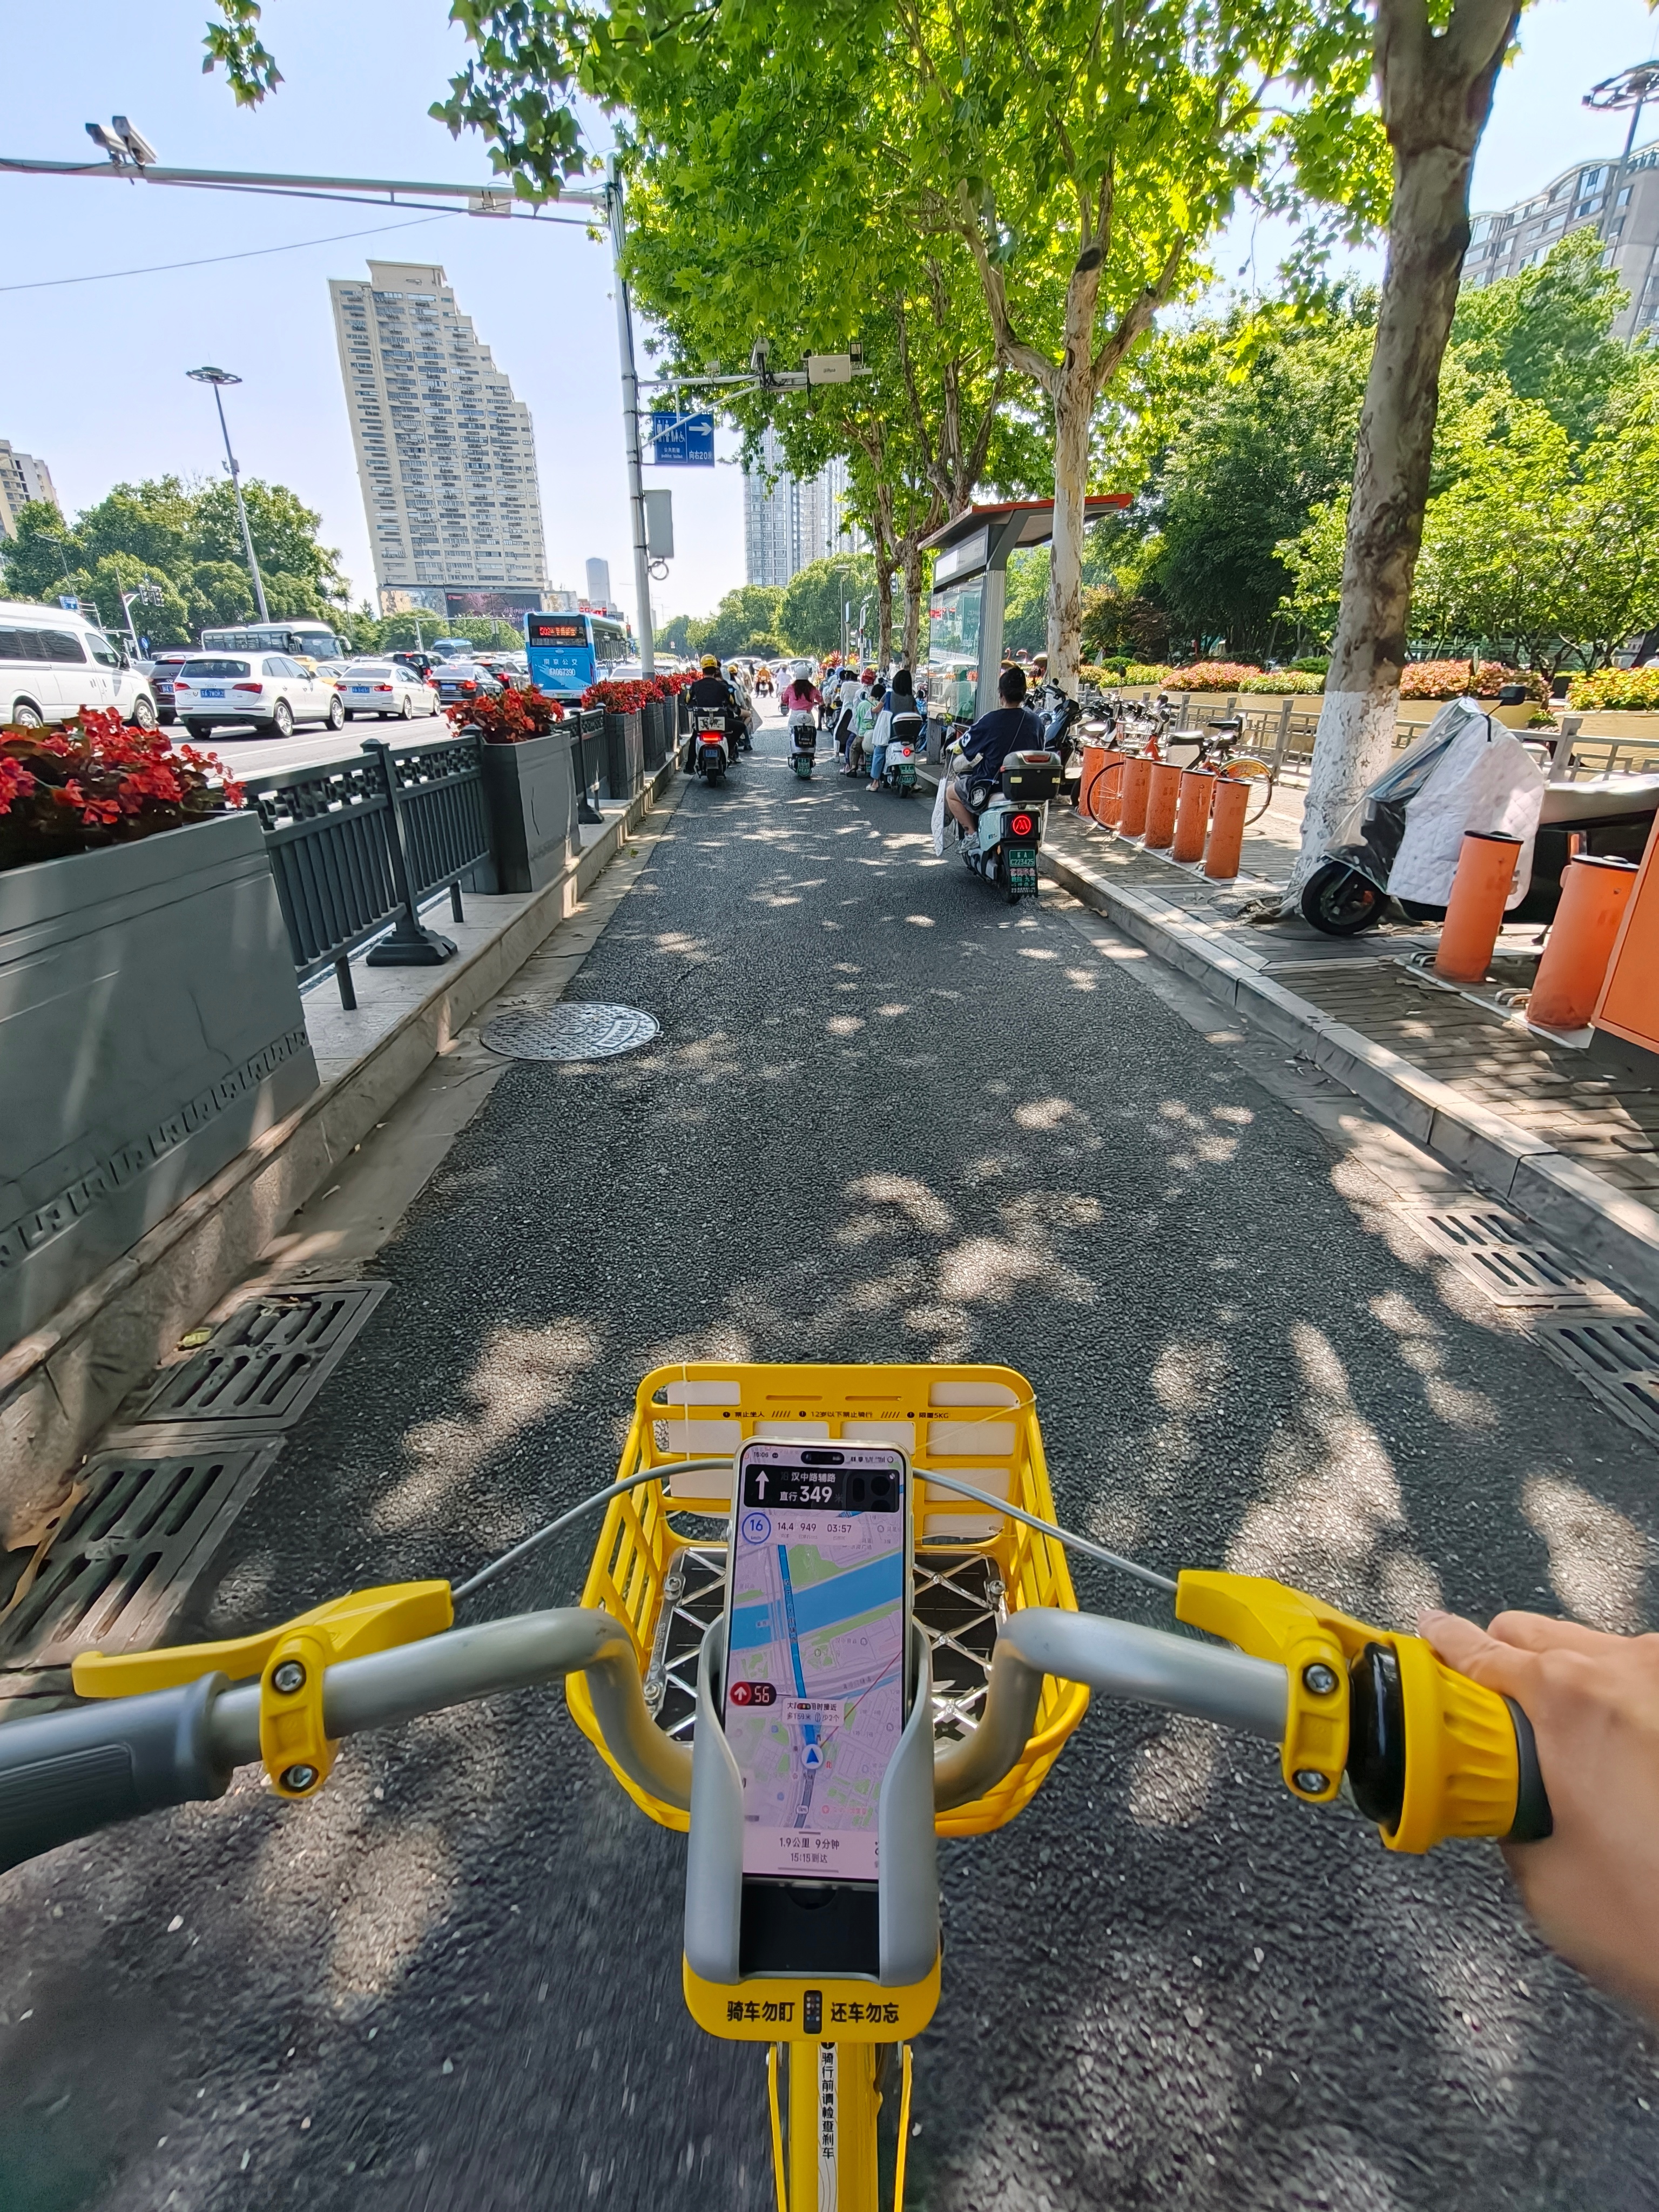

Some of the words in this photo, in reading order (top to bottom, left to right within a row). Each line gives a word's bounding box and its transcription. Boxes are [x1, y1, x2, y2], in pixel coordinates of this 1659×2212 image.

[689, 450, 712, 460] 向右20米
[799, 1486, 832, 1503] 349
[750, 1519, 763, 1532] 16
[778, 1522, 794, 1531] 14.4
[800, 1522, 817, 1532] 949
[827, 1524, 852, 1533] 03:57
[780, 1837, 810, 1849] 1.9公里
[815, 1838, 840, 1850] 9分钟
[727, 2001, 795, 2022] 骑车勿盯
[831, 2002, 899, 2024] 还车勿忘
